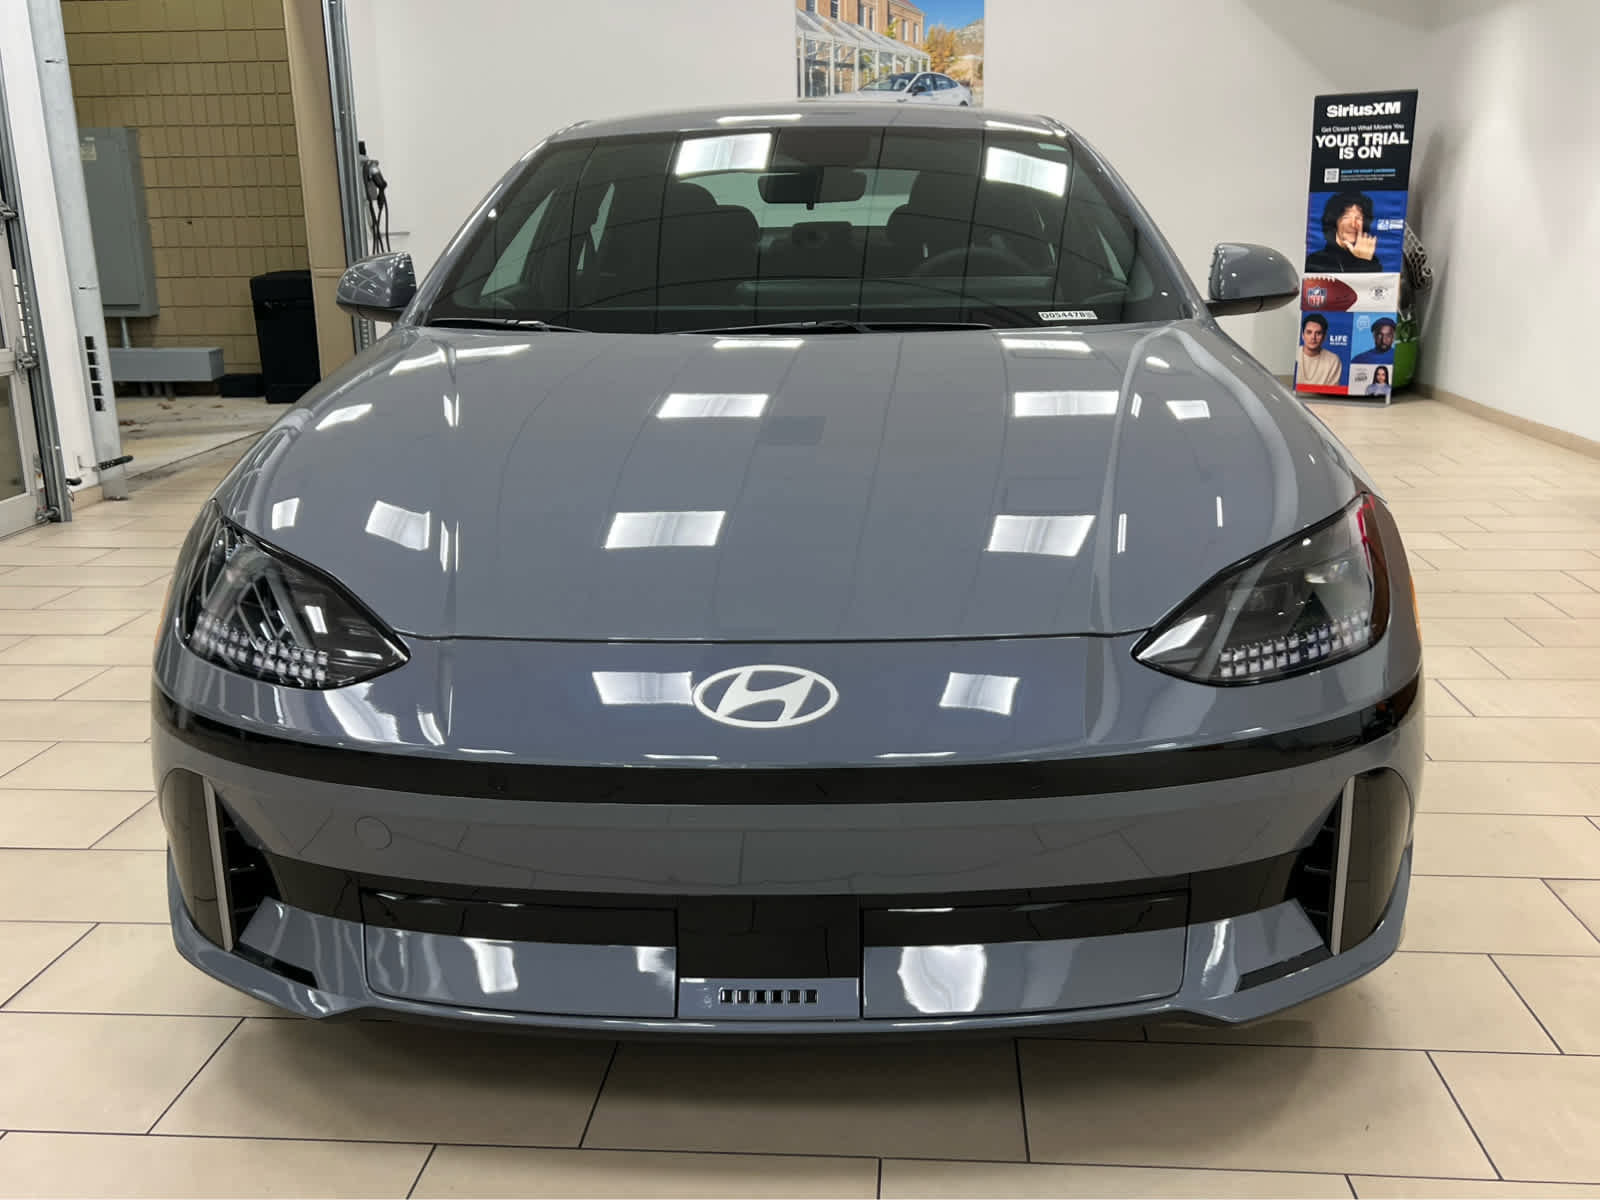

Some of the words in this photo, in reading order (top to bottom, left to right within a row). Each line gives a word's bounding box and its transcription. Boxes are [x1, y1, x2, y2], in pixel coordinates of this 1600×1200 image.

[1326, 101, 1401, 118] SiriusXM
[1357, 124, 1373, 132] What
[1315, 134, 1359, 149] YOUR
[1362, 132, 1409, 146] TRIAL
[1339, 147, 1354, 160] IS
[1357, 146, 1382, 159] ON
